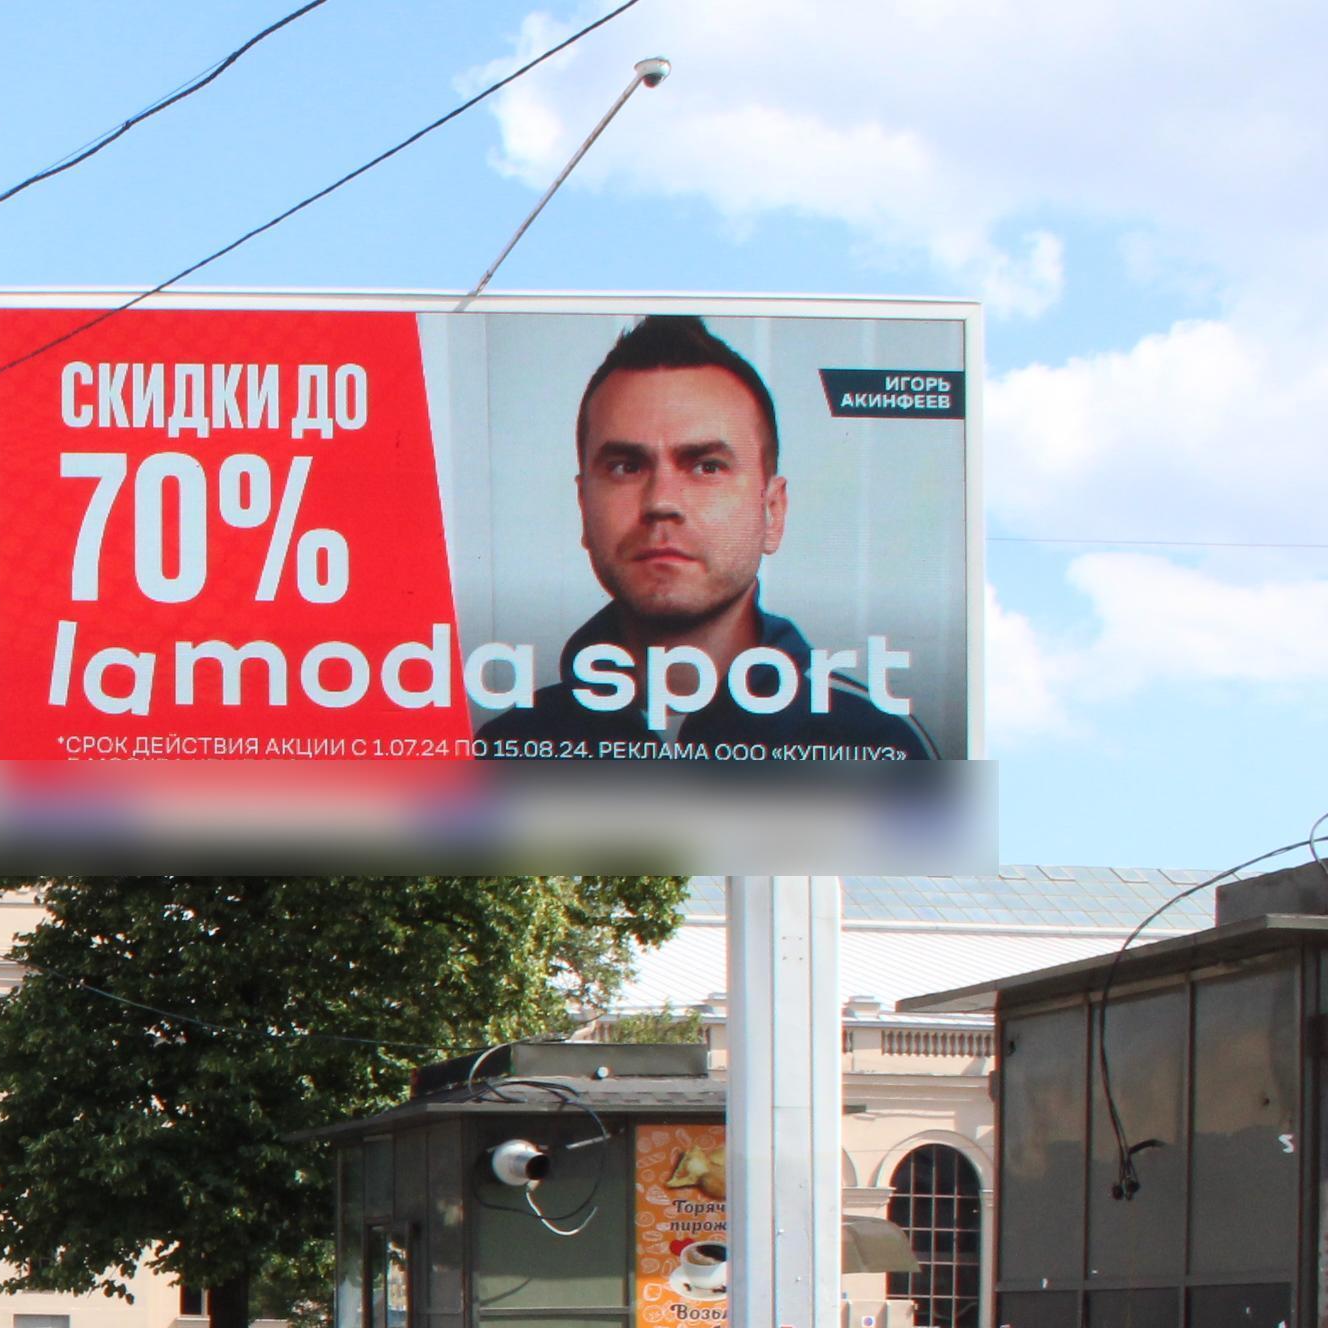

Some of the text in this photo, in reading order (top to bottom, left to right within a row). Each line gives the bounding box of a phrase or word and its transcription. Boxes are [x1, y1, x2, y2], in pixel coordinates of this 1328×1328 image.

[61, 361, 368, 439] СКИДКИ ДО
[840, 393, 951, 409] АКИНФЕЕВ
[885, 376, 951, 392] ИГОРЬ
[60, 452, 349, 603] 70%
[48, 619, 911, 731] lamoda sport
[132, 734, 260, 757] ДЕЙСТВИЯ
[265, 738, 345, 757] АКЦИИ
[351, 739, 367, 756] С
[373, 739, 450, 757] 1.07.24
[454, 739, 487, 758] ПО
[493, 739, 594, 758] 15.08.24.
[599, 741, 707, 759] РЕКЛАМА
[714, 743, 766, 760] ООО
